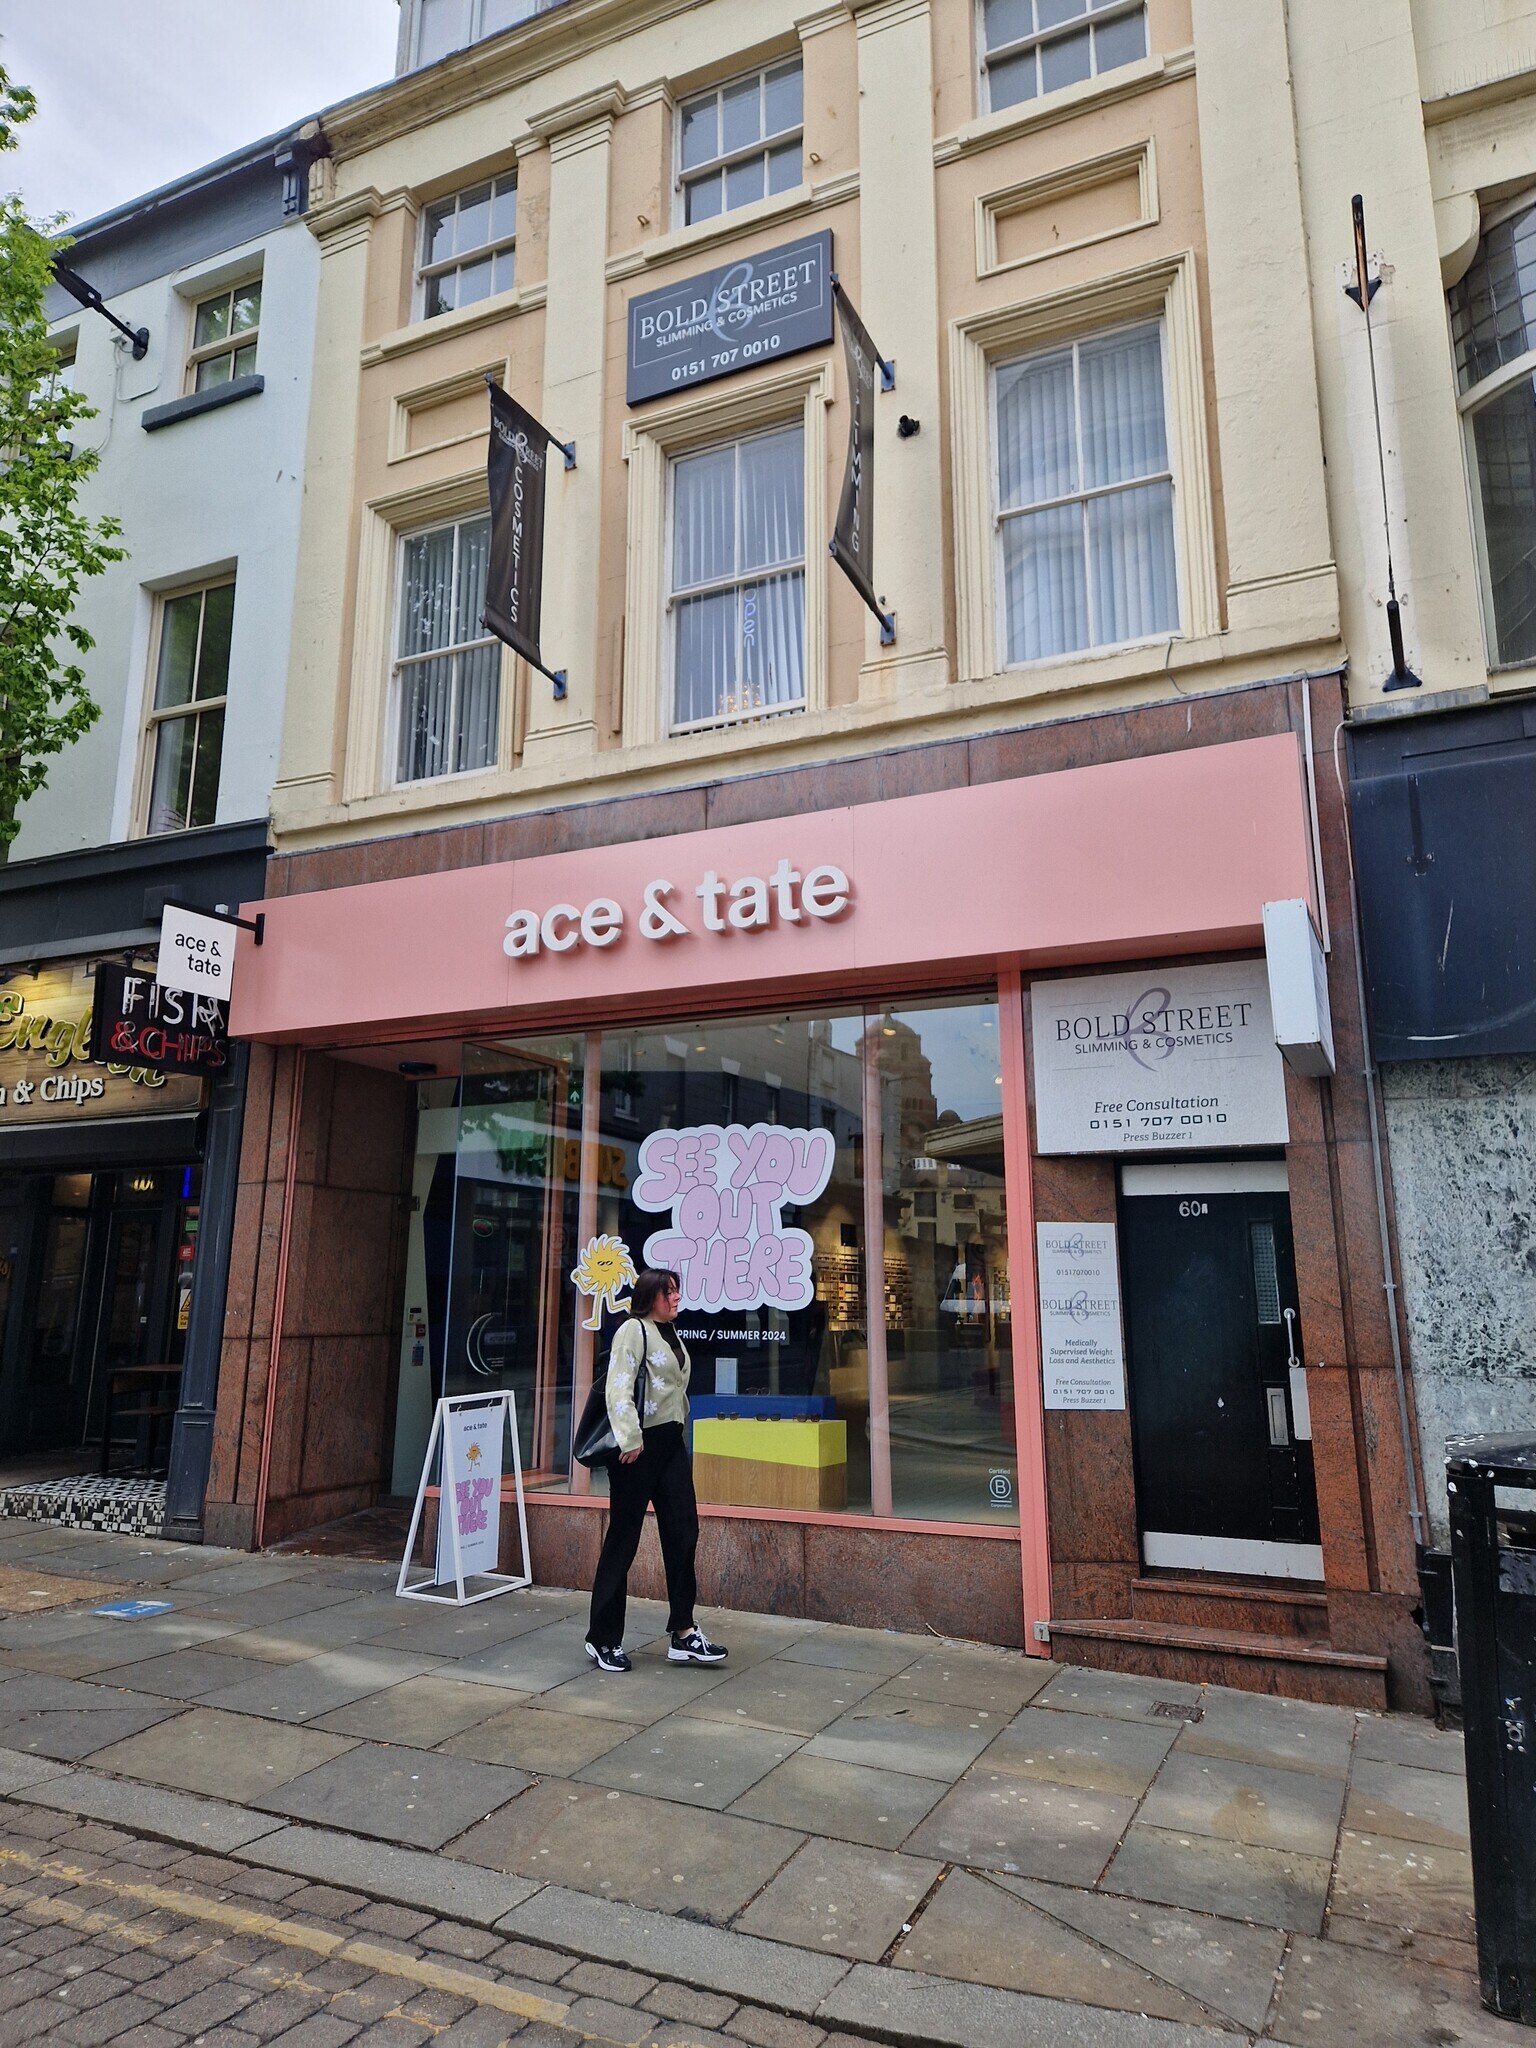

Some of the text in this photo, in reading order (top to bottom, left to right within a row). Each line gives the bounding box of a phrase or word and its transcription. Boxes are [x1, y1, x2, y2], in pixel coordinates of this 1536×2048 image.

[640, 259, 816, 340] BOLD STREET
[656, 290, 798, 348] SLIMMING & COSMETICS
[671, 334, 781, 381] 0151 707 0010
[510, 465, 524, 624] COSMETICS
[502, 857, 850, 959] ace & tate
[174, 932, 222, 957] ace &
[187, 954, 222, 977] tate
[1055, 1003, 1252, 1042] BOLD STREET
[1075, 1032, 1233, 1055] SLIMMING & COSMETICS
[13, 1079, 34, 1104] &
[40, 1074, 104, 1104] Chips
[1094, 1095, 1219, 1114] Free Consultation
[1090, 1113, 1227, 1129] 0151 707 0010
[1123, 1132, 1149, 1142] Press
[1152, 1131, 1188, 1141] Buzzer
[640, 1131, 827, 1203] SEE YOU
[679, 1181, 783, 1241] OUT
[1045, 1240, 1108, 1249] BOLD STREET
[651, 1234, 806, 1304] THERE
[1042, 1299, 1117, 1311] BOLD STREET
[677, 1329, 786, 1341] PRING / SUMMER 2024
[1065, 1339, 1098, 1348] Medically
[1050, 1348, 1113, 1358] Supervised Weight
[1080, 1357, 1115, 1365] Aesthetics
[1055, 1378, 1112, 1386] Free Consultation
[1062, 1396, 1080, 1404] Press
[472, 1477, 494, 1497] YOU
